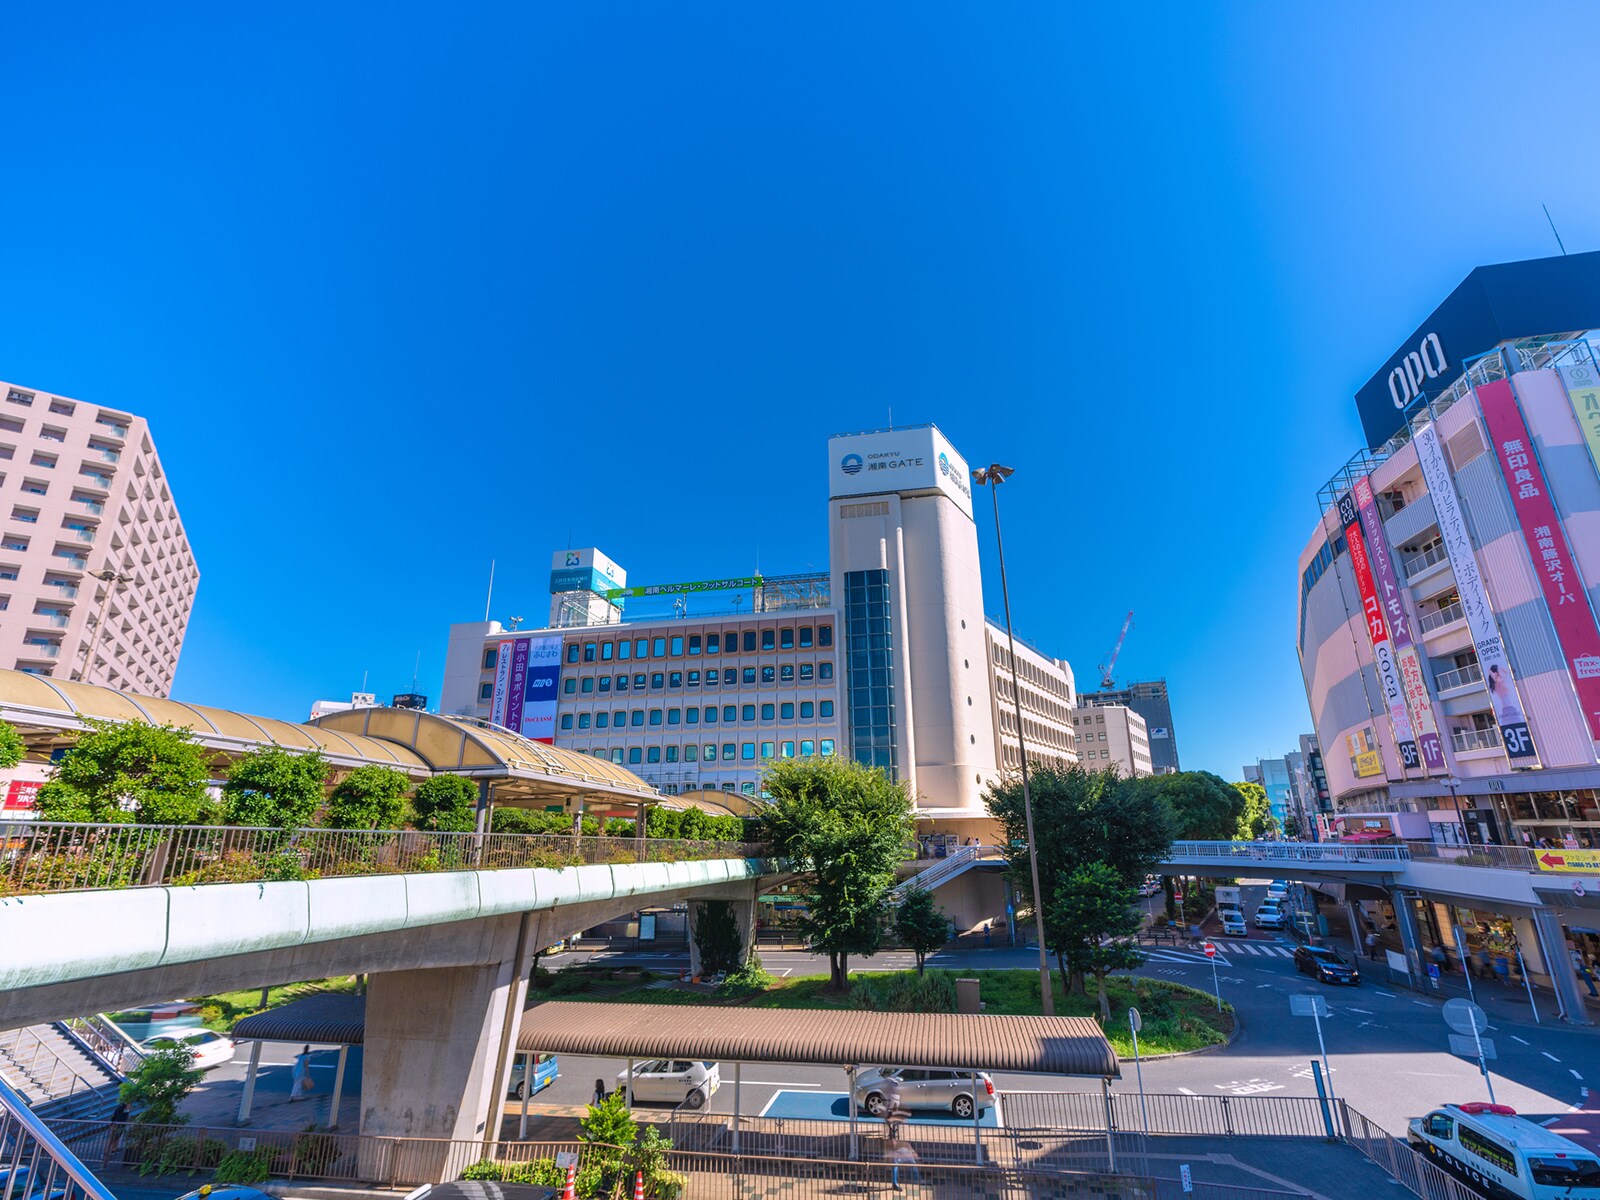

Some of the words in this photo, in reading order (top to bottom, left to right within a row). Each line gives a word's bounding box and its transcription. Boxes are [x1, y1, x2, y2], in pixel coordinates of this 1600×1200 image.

[867, 451, 900, 459] ODAKYU
[868, 461, 887, 471] 湘南
[888, 457, 924, 469] GATE
[1502, 438, 1540, 500] 無印良品
[1366, 509, 1387, 575] ドラッグストア
[1533, 525, 1576, 606] 湘南藤沢オーパ
[1364, 595, 1383, 638] コカ
[533, 650, 558, 659] ふじさわ
[1476, 636, 1500, 650] GRAND
[1480, 645, 1500, 656] OPEN
[1378, 647, 1398, 700] coca
[1406, 655, 1428, 711] 処方せん
[1423, 739, 1440, 761] 1F
[1504, 727, 1530, 753] 3F
[1401, 744, 1418, 765] 8F
[20, 786, 38, 794] 三井の
[1436, 1150, 1491, 1189] POLICE
